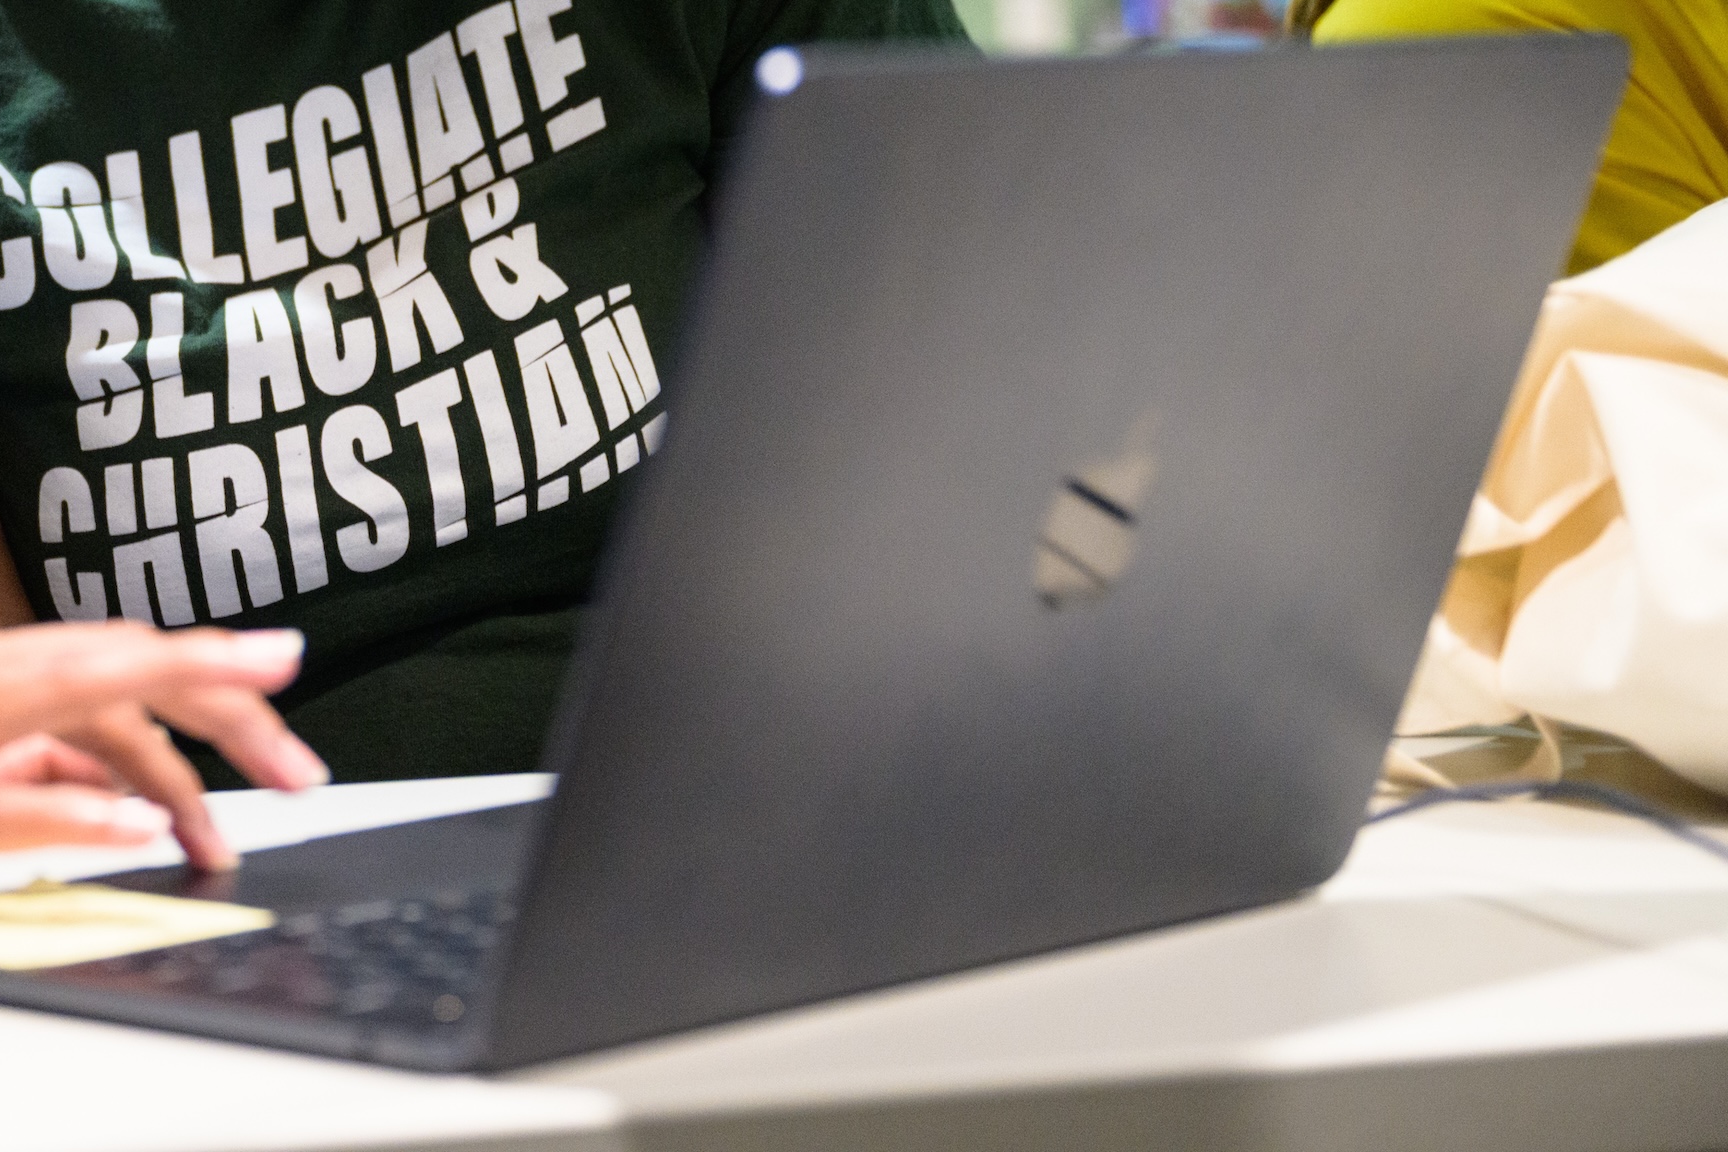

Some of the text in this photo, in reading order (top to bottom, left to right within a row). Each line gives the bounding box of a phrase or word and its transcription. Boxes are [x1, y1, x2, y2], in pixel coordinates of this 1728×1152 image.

[38, 282, 669, 628] CHRISTIAN
[65, 176, 570, 451] BLACK &
